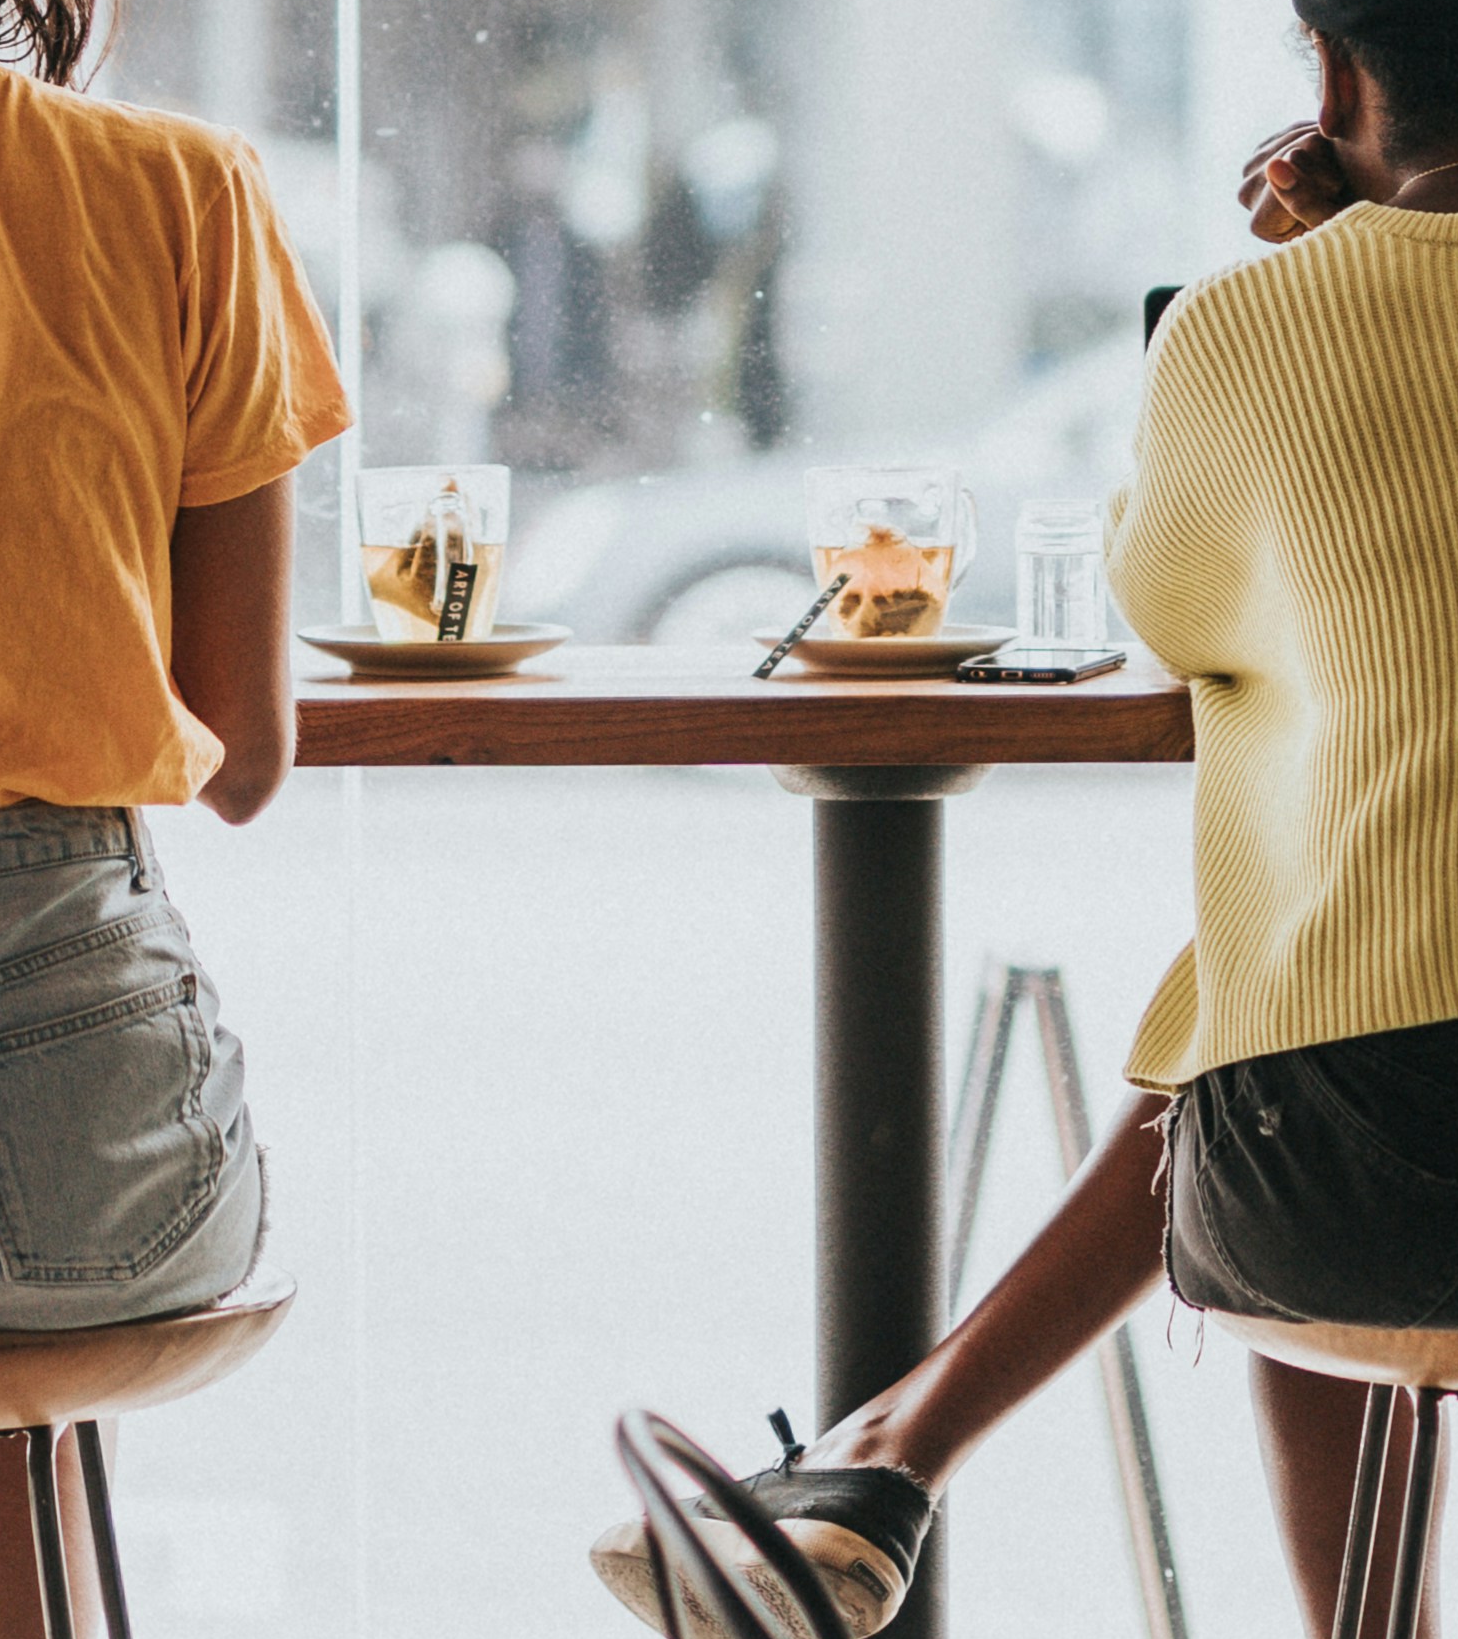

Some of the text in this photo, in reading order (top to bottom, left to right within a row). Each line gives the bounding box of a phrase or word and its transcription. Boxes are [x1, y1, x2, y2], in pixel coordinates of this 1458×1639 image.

[443, 570, 469, 640] ART OF TE
[761, 580, 842, 670] ART OF TEA
